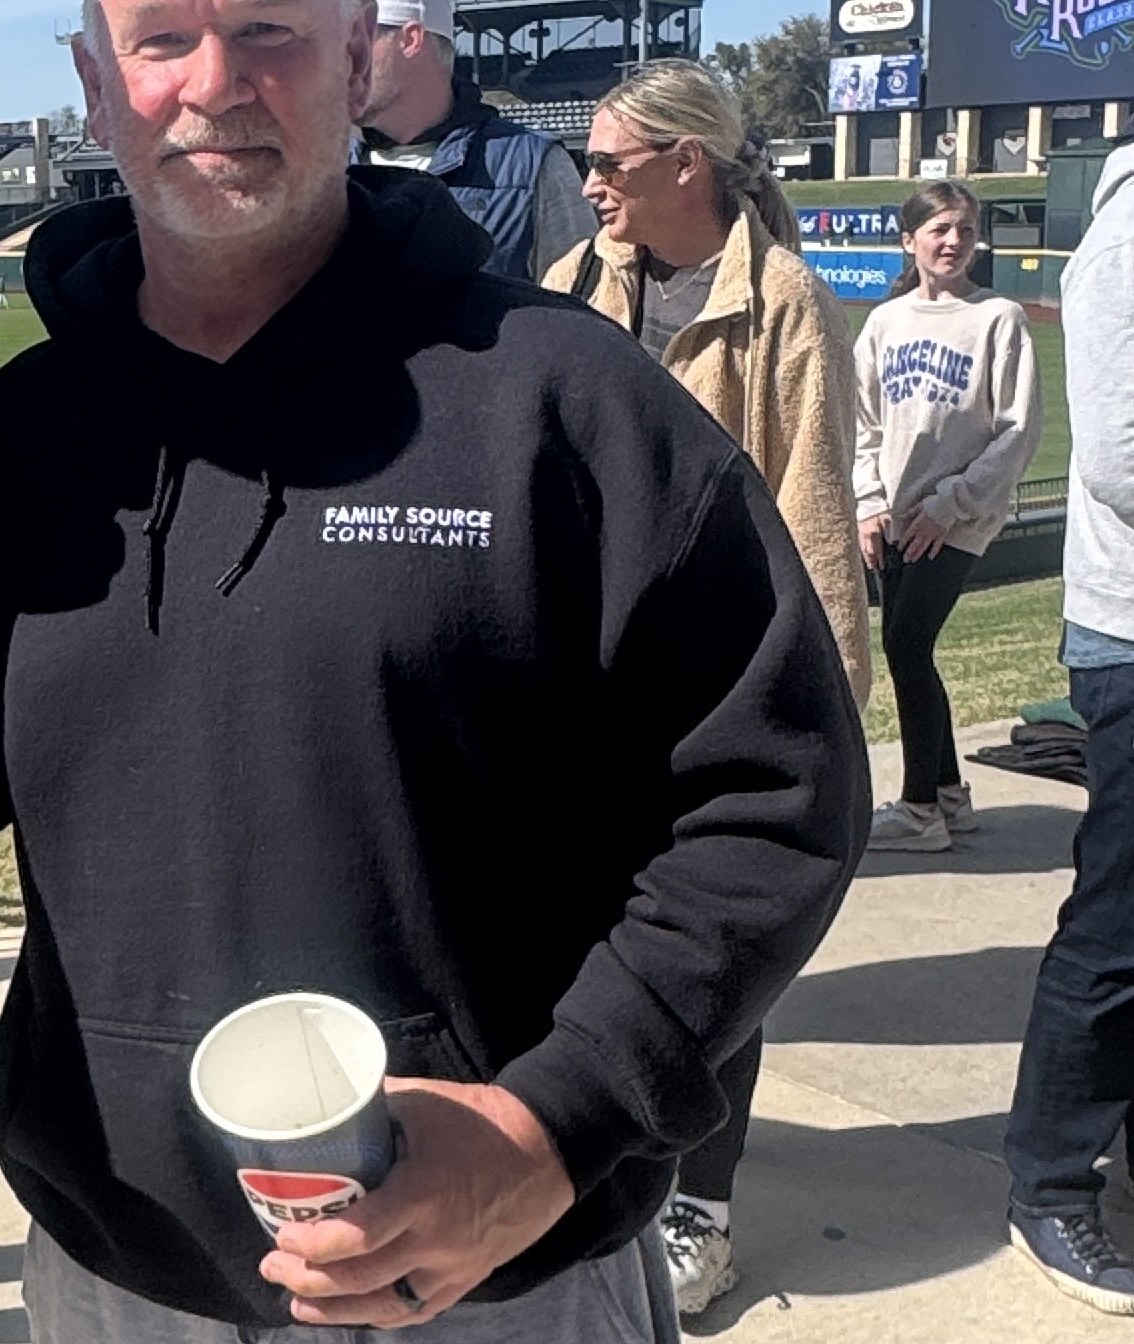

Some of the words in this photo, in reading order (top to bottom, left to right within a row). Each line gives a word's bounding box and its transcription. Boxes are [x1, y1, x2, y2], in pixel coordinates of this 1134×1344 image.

[324, 506, 400, 524] FAMILY
[405, 507, 493, 529] SOURCE
[322, 526, 491, 548] CONSULTANTS
